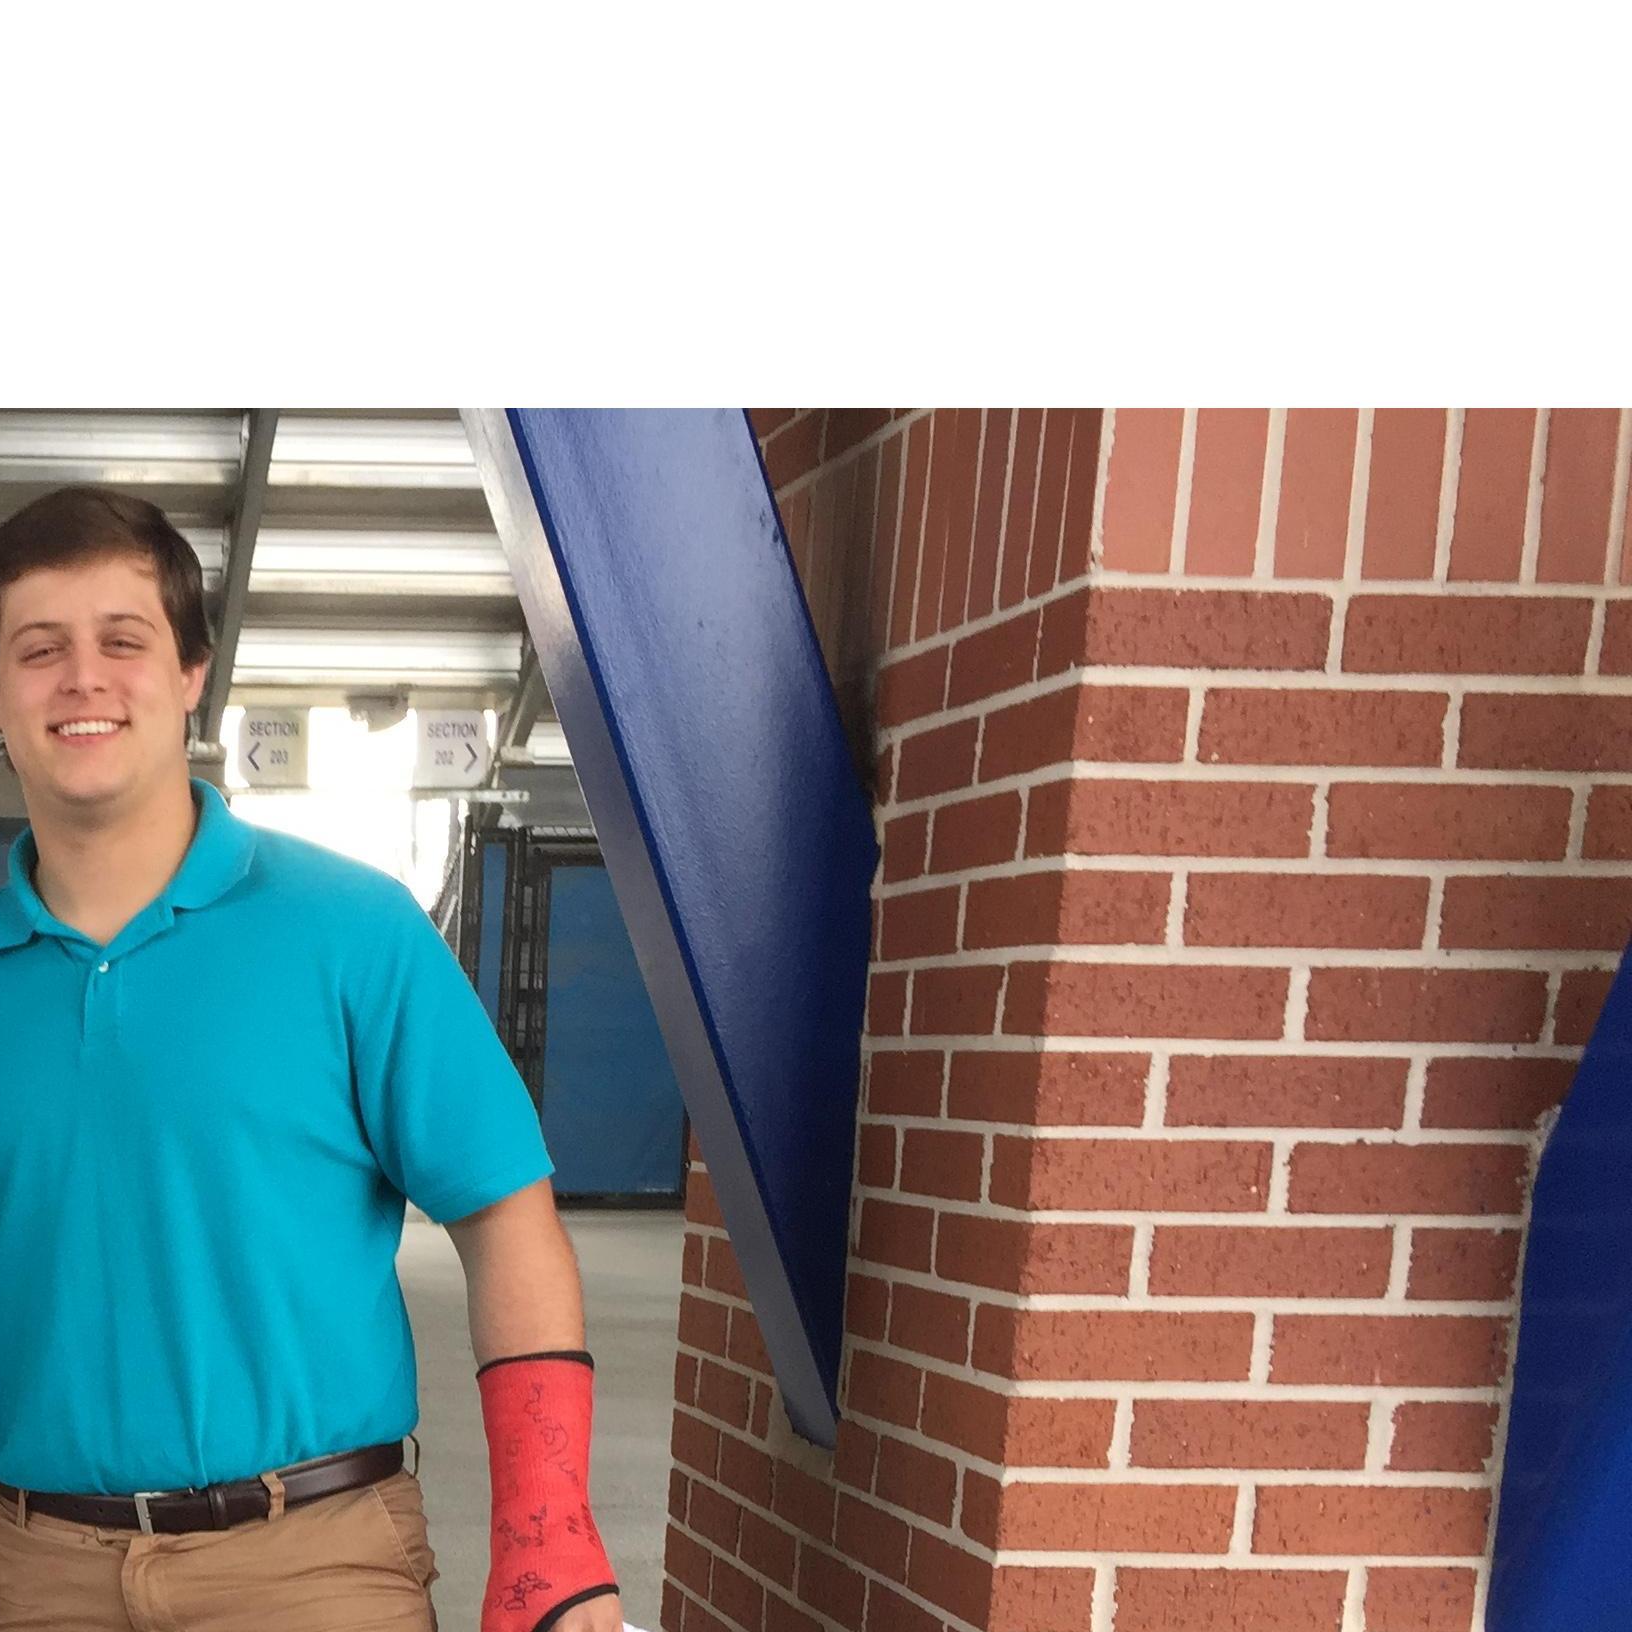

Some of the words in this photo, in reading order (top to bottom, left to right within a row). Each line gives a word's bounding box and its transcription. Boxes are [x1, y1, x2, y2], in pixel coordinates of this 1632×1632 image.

[249, 722, 299, 737] SECTION
[428, 722, 478, 738] SECTION
[270, 750, 288, 765] 203
[435, 751, 454, 765] 202
